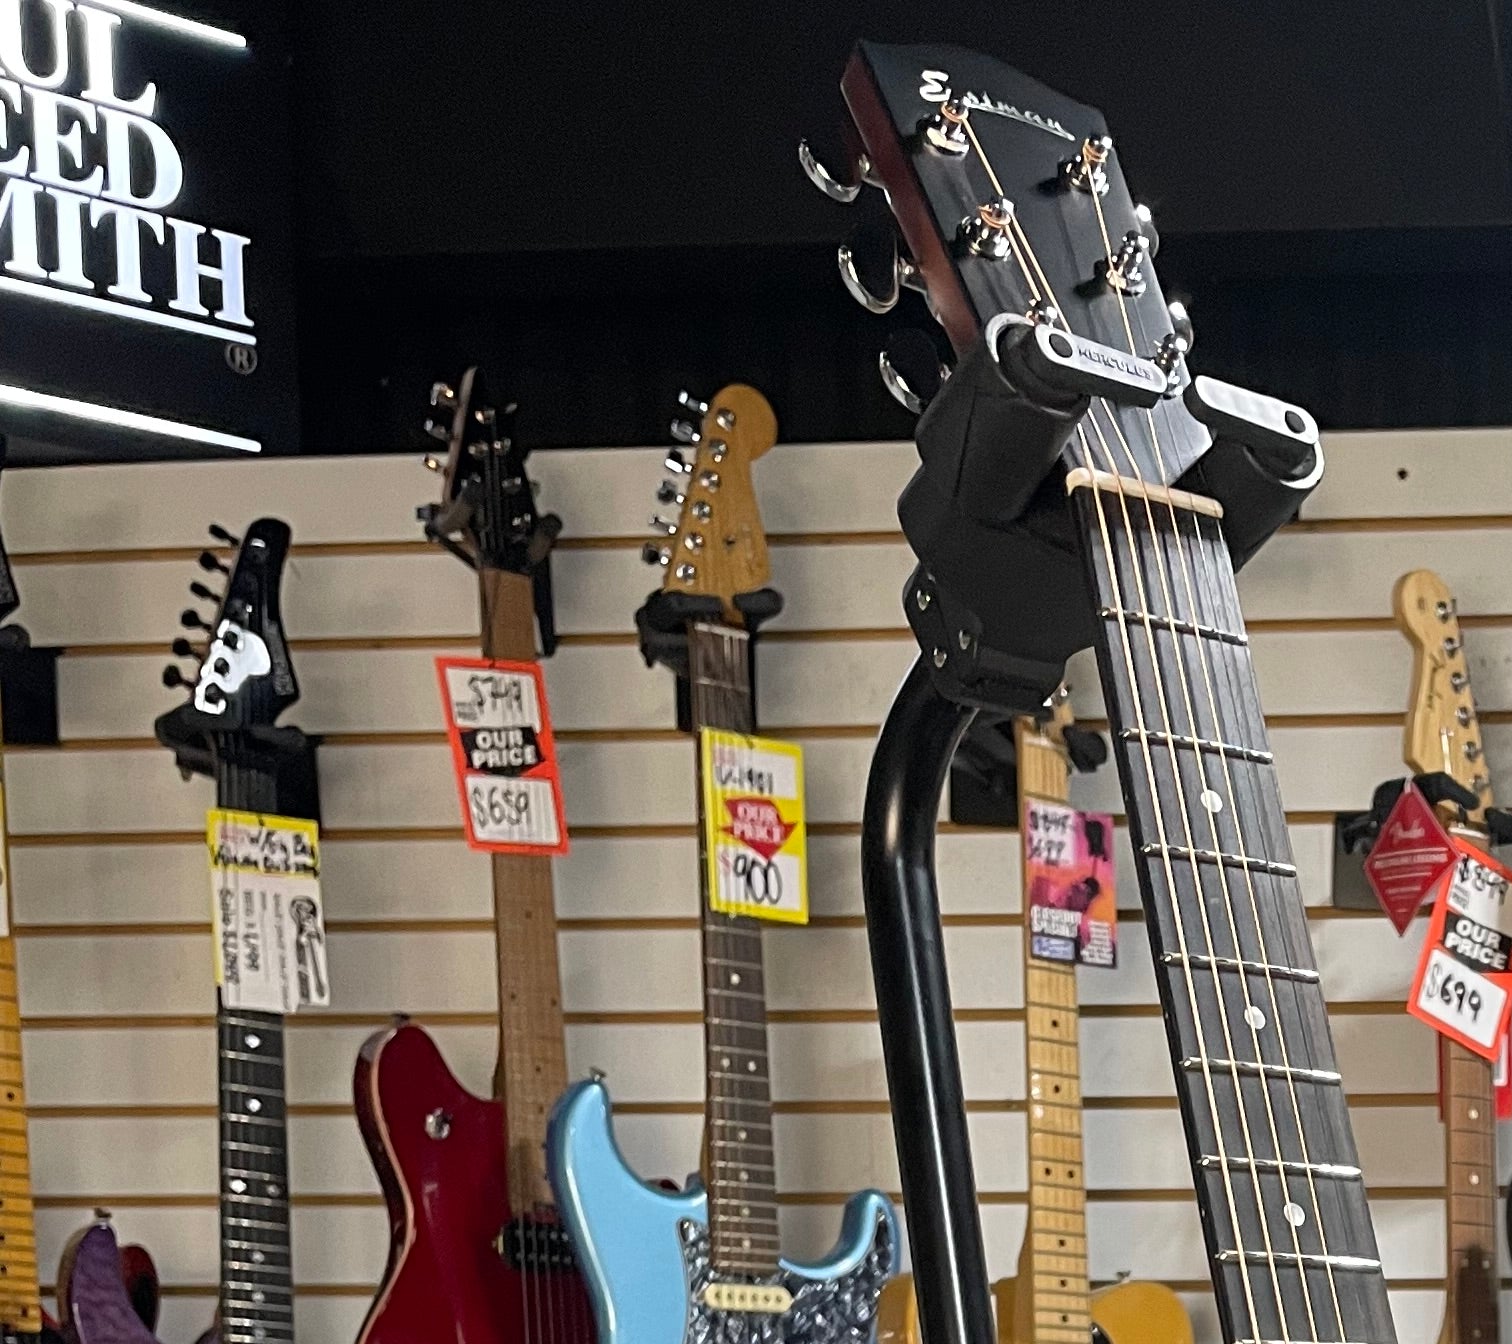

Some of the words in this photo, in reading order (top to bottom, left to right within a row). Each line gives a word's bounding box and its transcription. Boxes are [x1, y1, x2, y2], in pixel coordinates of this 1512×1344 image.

[475, 729, 524, 750] OUR
[472, 745, 539, 769] PRICE
[736, 801, 780, 825] OUR
[1454, 919, 1503, 949] OUR
[1445, 932, 1508, 970] PRICE
[1425, 961, 1482, 1024] $699
